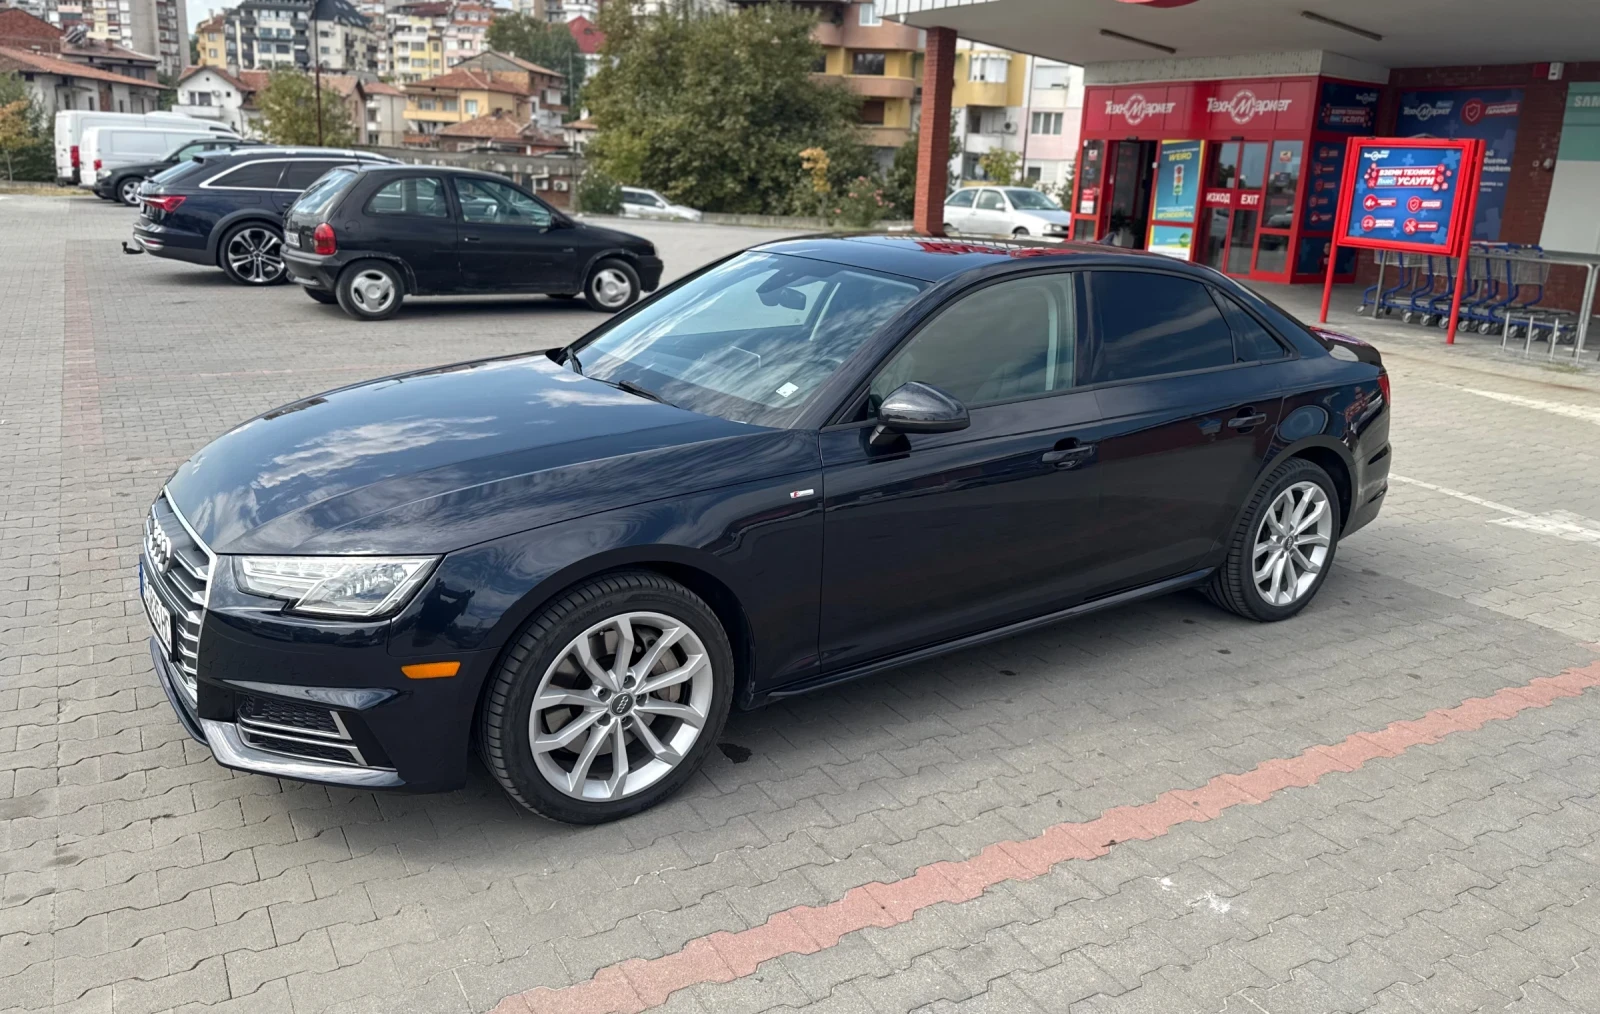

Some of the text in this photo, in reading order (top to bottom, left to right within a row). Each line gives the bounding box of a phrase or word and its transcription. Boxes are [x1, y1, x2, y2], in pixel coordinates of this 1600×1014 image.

[1169, 151, 1192, 161] WEIRD
[1379, 168, 1403, 176] ВЗЕМИ
[1396, 176, 1435, 185] УСЛУГИ
[1206, 192, 1231, 204] ИЗХОД
[1240, 194, 1260, 205] EXIT
